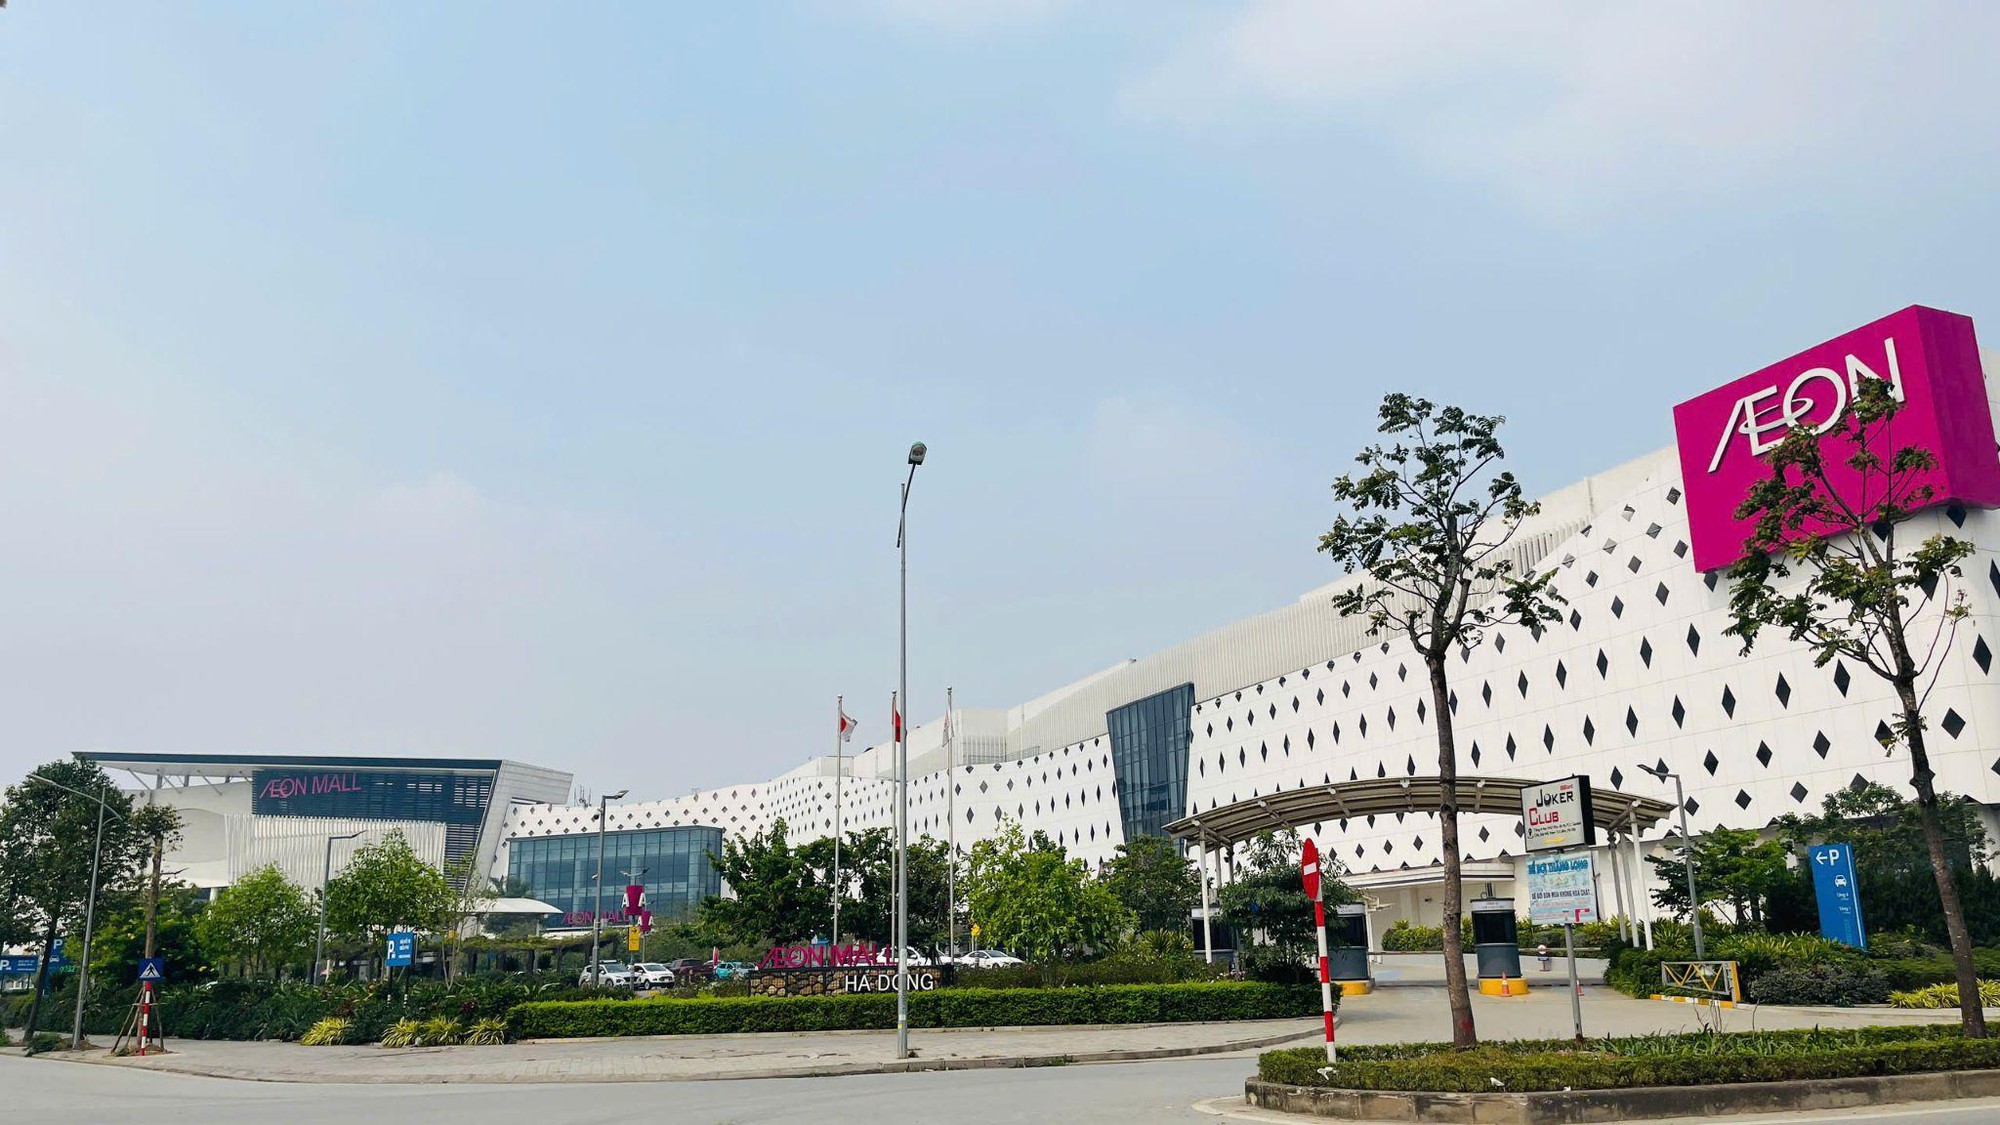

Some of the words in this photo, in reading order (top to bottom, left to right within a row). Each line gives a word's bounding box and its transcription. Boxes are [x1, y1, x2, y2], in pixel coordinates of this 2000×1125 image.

[312, 773, 362, 794] MALL
[1536, 788, 1574, 807] JOKER
[1528, 808, 1559, 825] CLUB
[1829, 849, 1839, 866] P
[53, 939, 63, 949] P
[830, 943, 899, 967] MALL
